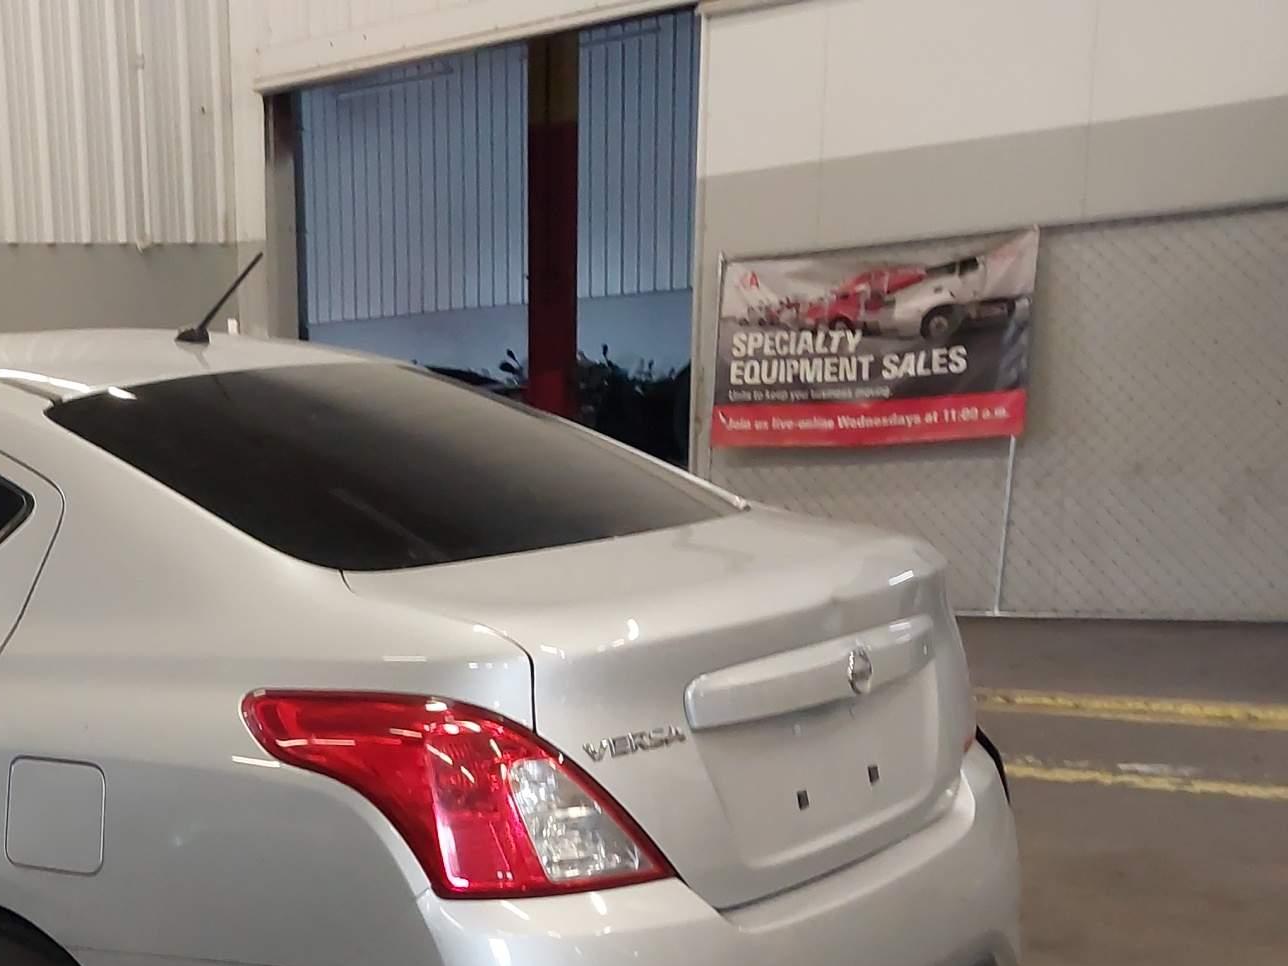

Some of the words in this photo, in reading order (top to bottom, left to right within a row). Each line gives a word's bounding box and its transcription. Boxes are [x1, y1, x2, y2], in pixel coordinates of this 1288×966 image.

[732, 329, 862, 358] SPECIALTY
[730, 354, 874, 386] EQUIPMENT
[881, 345, 968, 381] SALES
[837, 412, 921, 430] Wednesdays
[924, 410, 939, 424] at
[582, 725, 686, 762] VERSA
